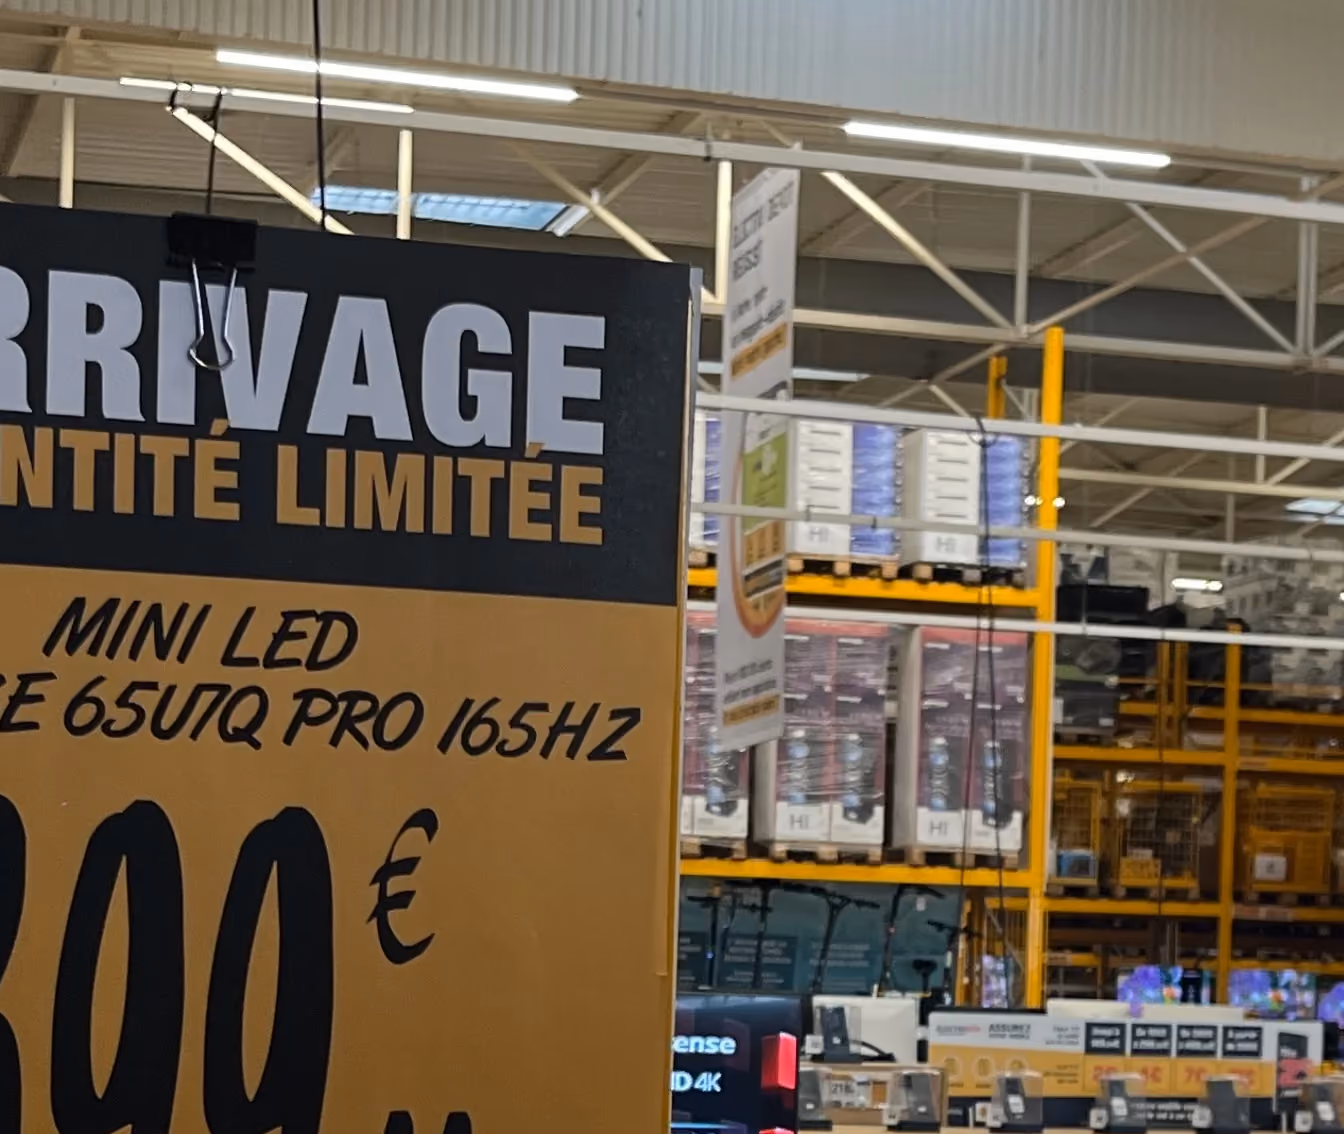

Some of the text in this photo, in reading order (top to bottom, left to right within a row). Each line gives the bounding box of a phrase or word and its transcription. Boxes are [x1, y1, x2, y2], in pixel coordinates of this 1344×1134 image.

[275, 440, 605, 546] LIMITÉE
[42, 596, 360, 671] MINI LED
[63, 675, 270, 750] 65U7Q
[282, 687, 425, 751] PRO
[436, 697, 642, 762] 165HZ
[365, 806, 440, 966] €
[672, 1035, 737, 1054] ense
[694, 1072, 723, 1092] 4K
